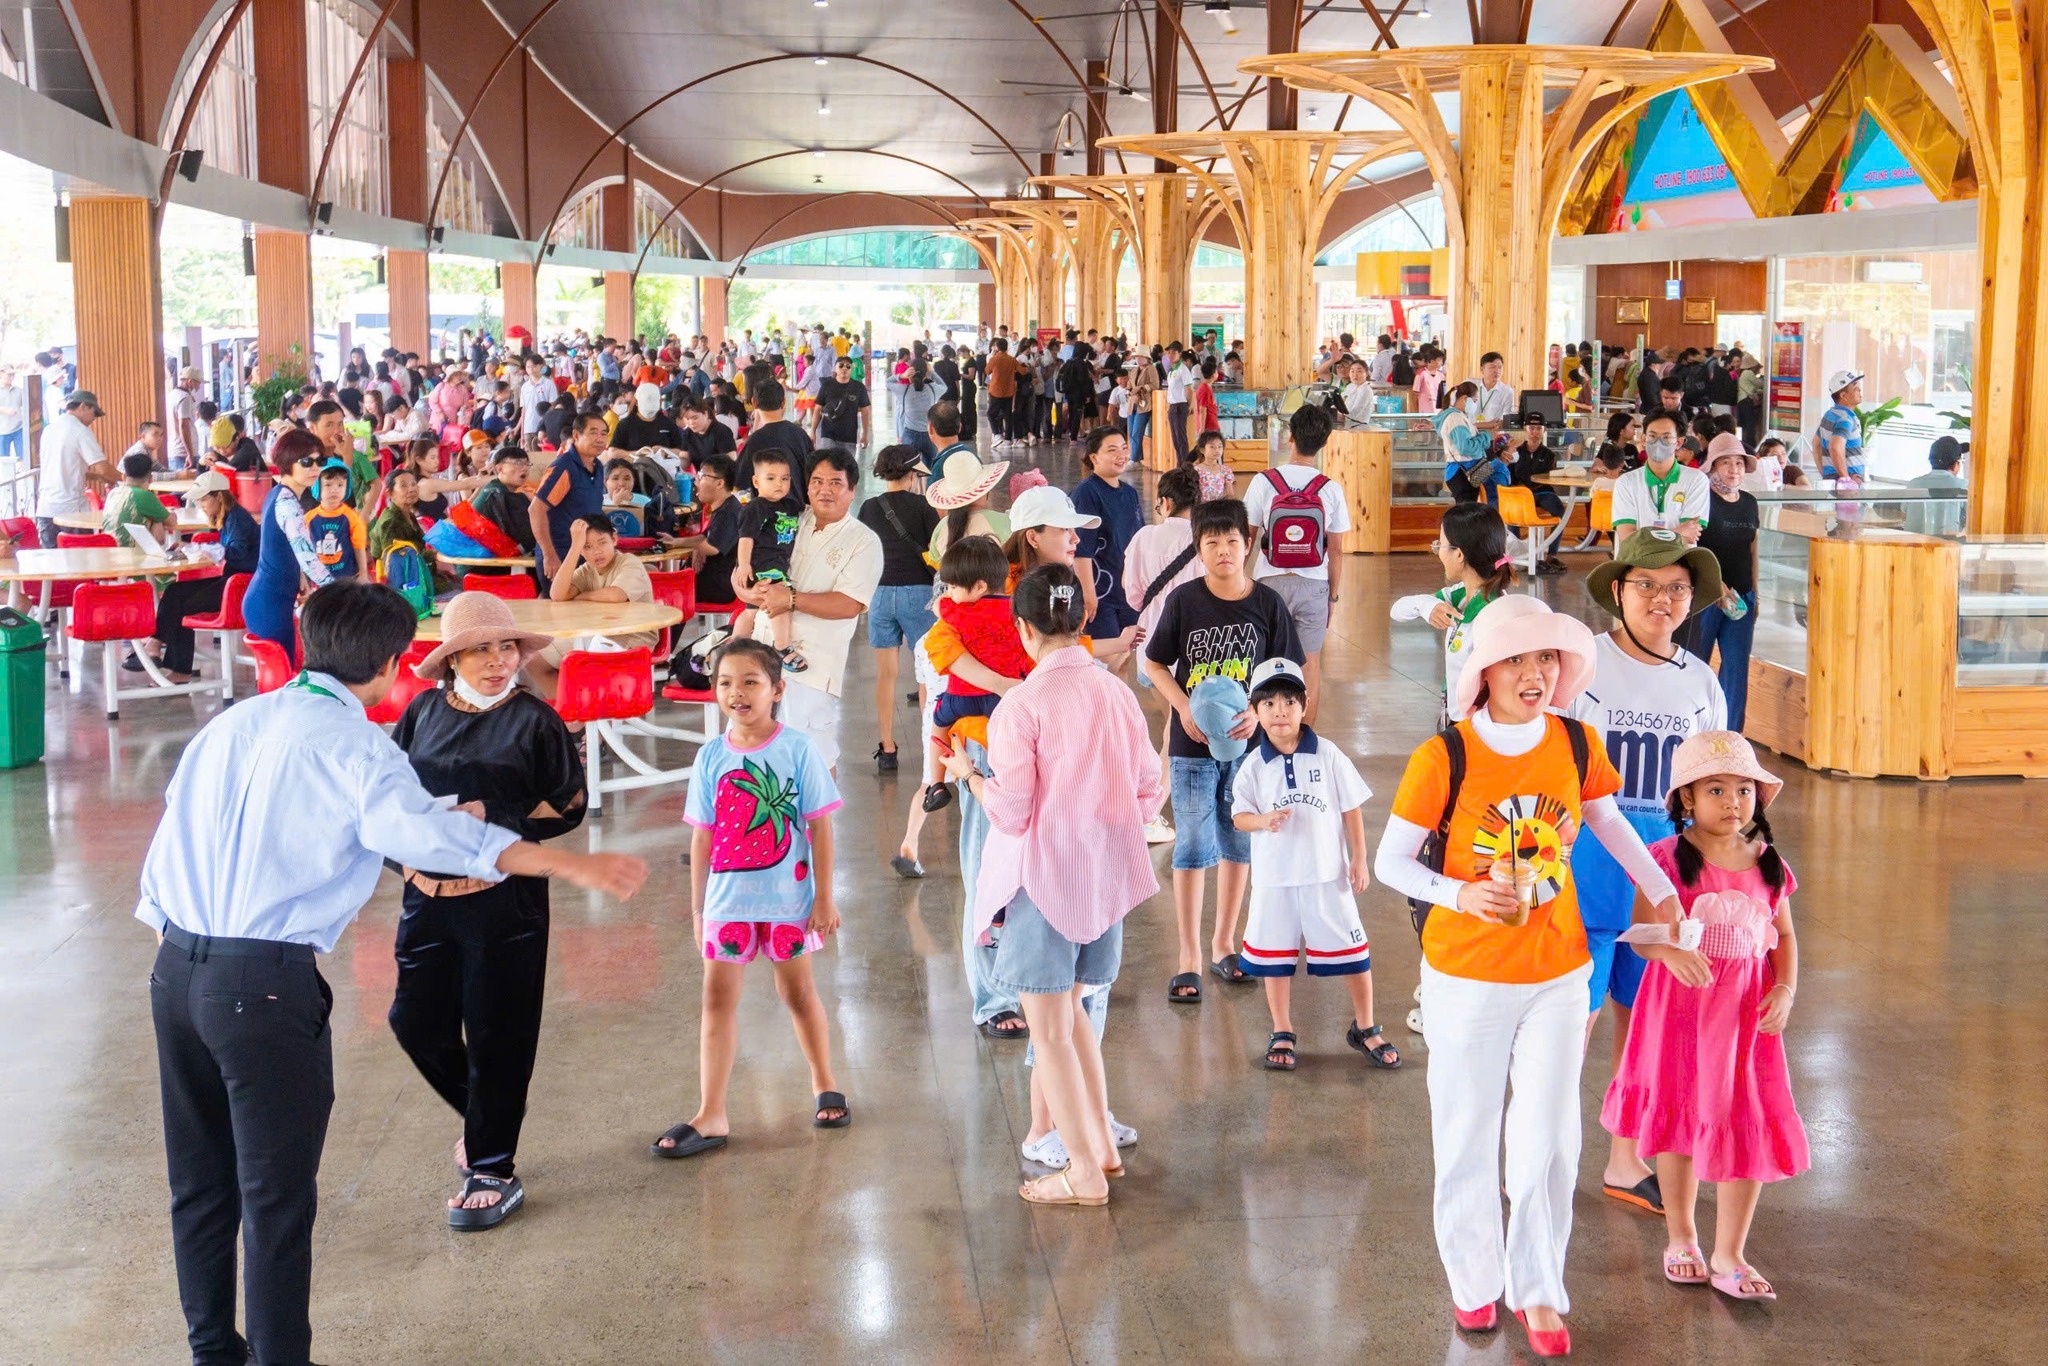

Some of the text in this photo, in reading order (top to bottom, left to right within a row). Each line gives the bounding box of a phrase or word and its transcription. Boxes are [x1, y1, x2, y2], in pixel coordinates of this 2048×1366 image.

[1187, 623, 1258, 657] RUN
[1607, 709, 1691, 733] 123456789
[1309, 769, 1321, 783] 12
[1272, 793, 1328, 813] AGICKIDS
[1639, 806, 1657, 814] count
[1350, 928, 1363, 944] 12
